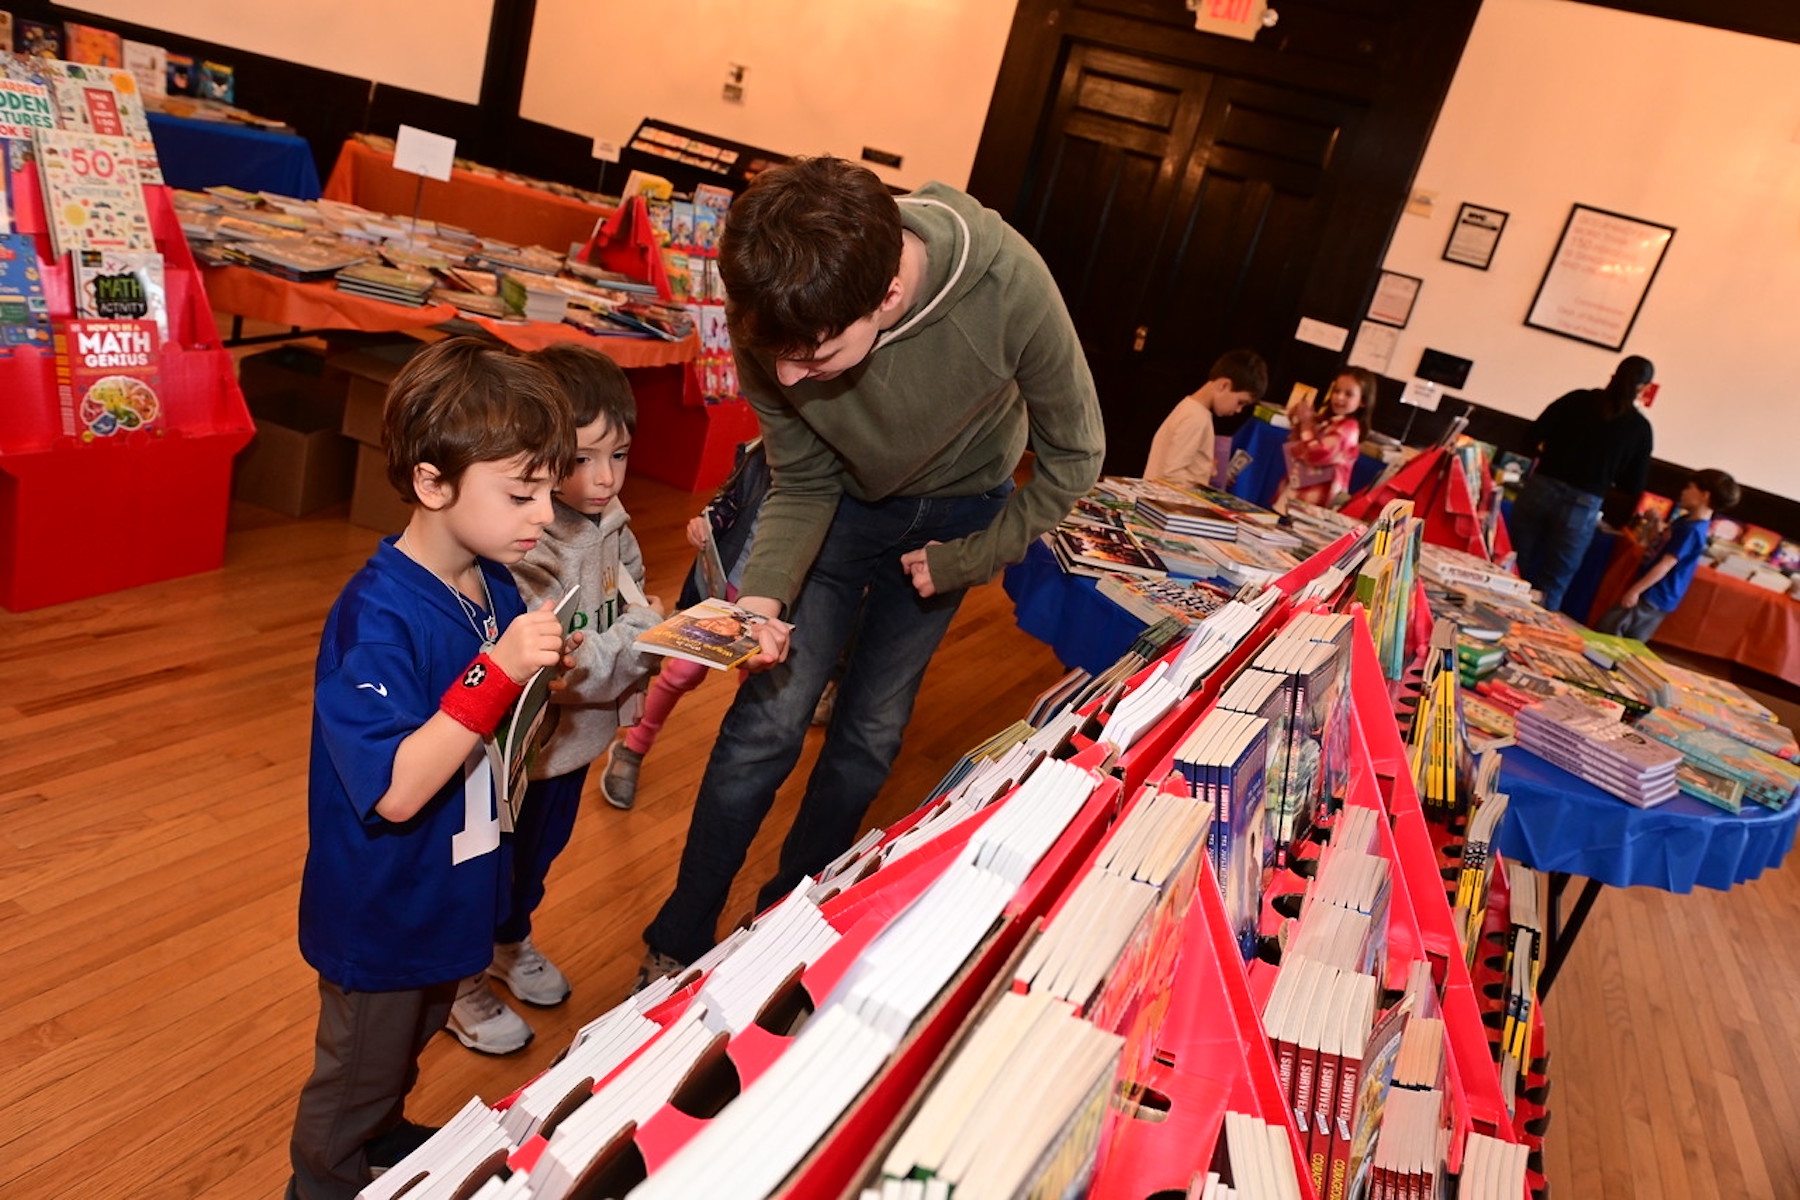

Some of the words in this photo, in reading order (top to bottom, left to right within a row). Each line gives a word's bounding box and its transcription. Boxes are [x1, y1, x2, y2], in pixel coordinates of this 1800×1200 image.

[0, 111, 53, 128] TURES
[71, 147, 114, 178] 50
[98, 278, 143, 298] MATH
[100, 302, 145, 314] ACTIVITY
[86, 323, 108, 332] HOW
[77, 331, 151, 355] MATH
[84, 352, 149, 368] GENIUS
[1220, 788, 1230, 823] SURVIVED
[1297, 1065, 1312, 1112] SURVIVED
[1318, 1068, 1334, 1115] SURVIVED
[1340, 1073, 1356, 1121] SURVIVED
